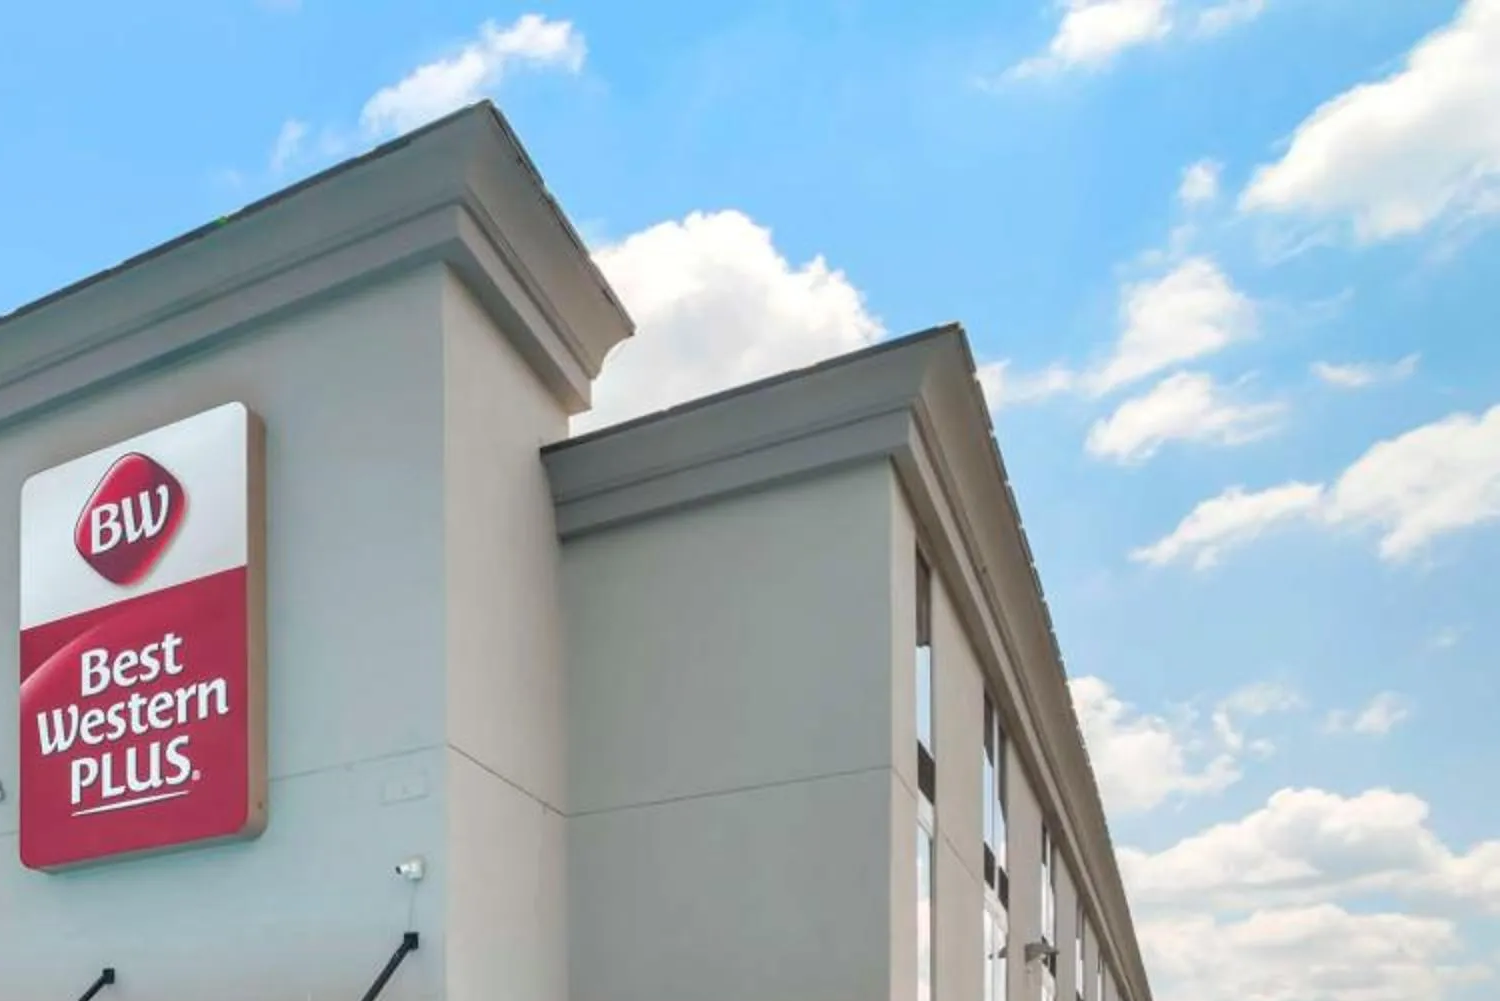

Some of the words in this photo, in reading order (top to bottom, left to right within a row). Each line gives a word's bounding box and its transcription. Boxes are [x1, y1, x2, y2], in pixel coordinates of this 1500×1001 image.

[89, 484, 171, 555] BW
[80, 632, 183, 697] Best
[36, 676, 229, 756] Western
